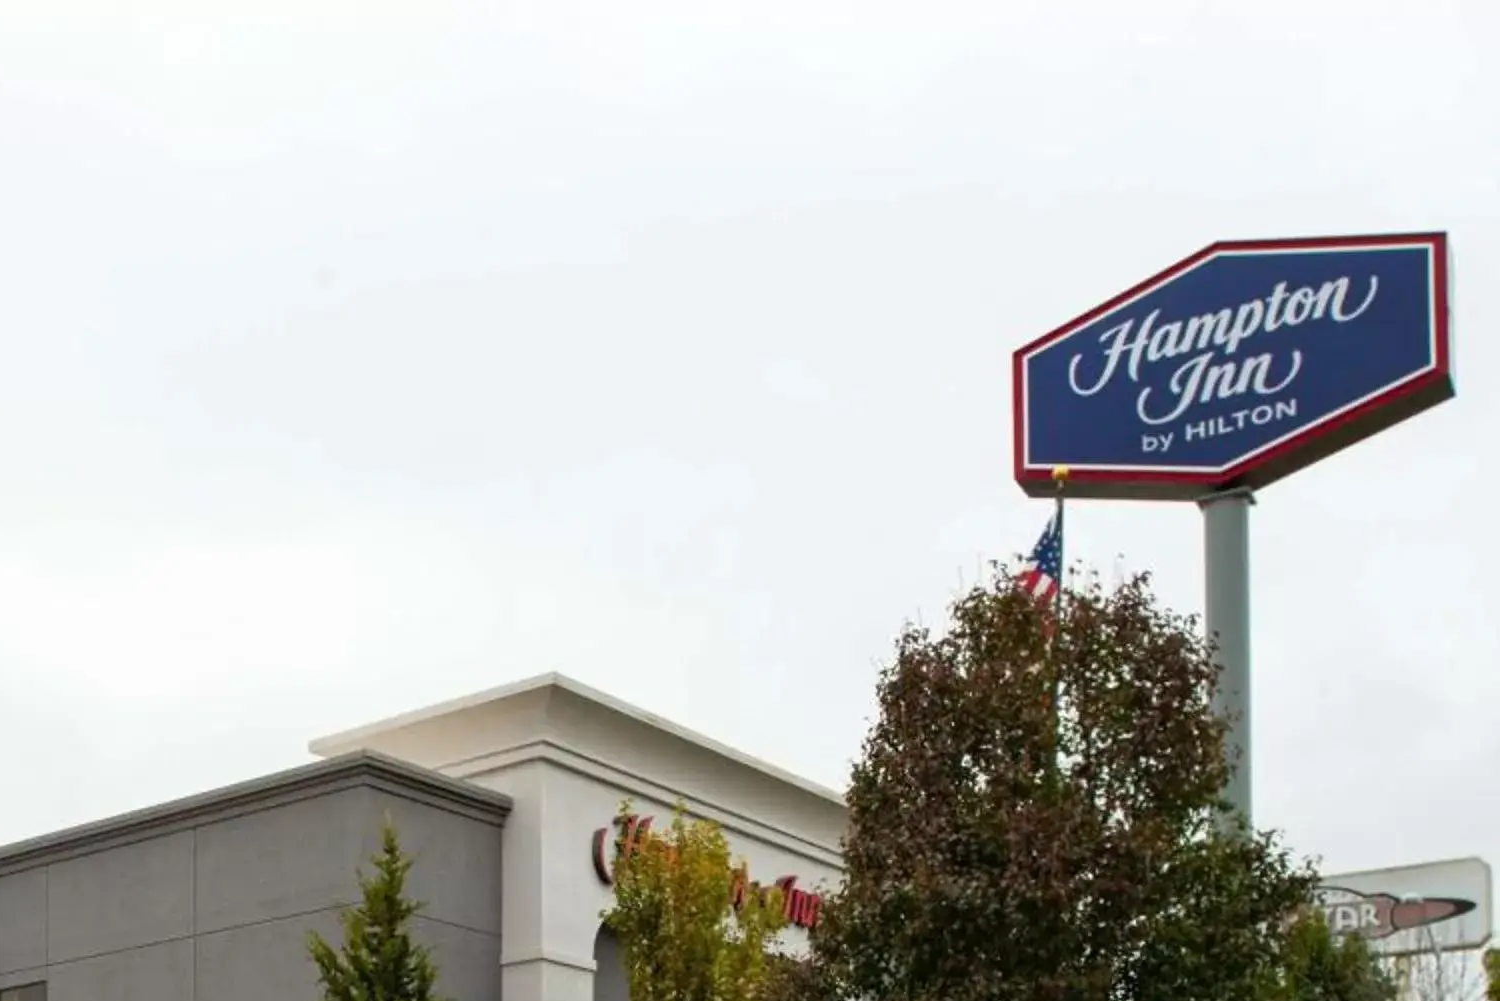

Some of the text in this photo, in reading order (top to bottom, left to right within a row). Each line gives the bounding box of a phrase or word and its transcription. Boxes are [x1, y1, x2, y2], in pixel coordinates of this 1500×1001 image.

[1069, 275, 1378, 396] Hampton
[1137, 350, 1301, 425] Inn
[1142, 398, 1297, 452] by HILTON
